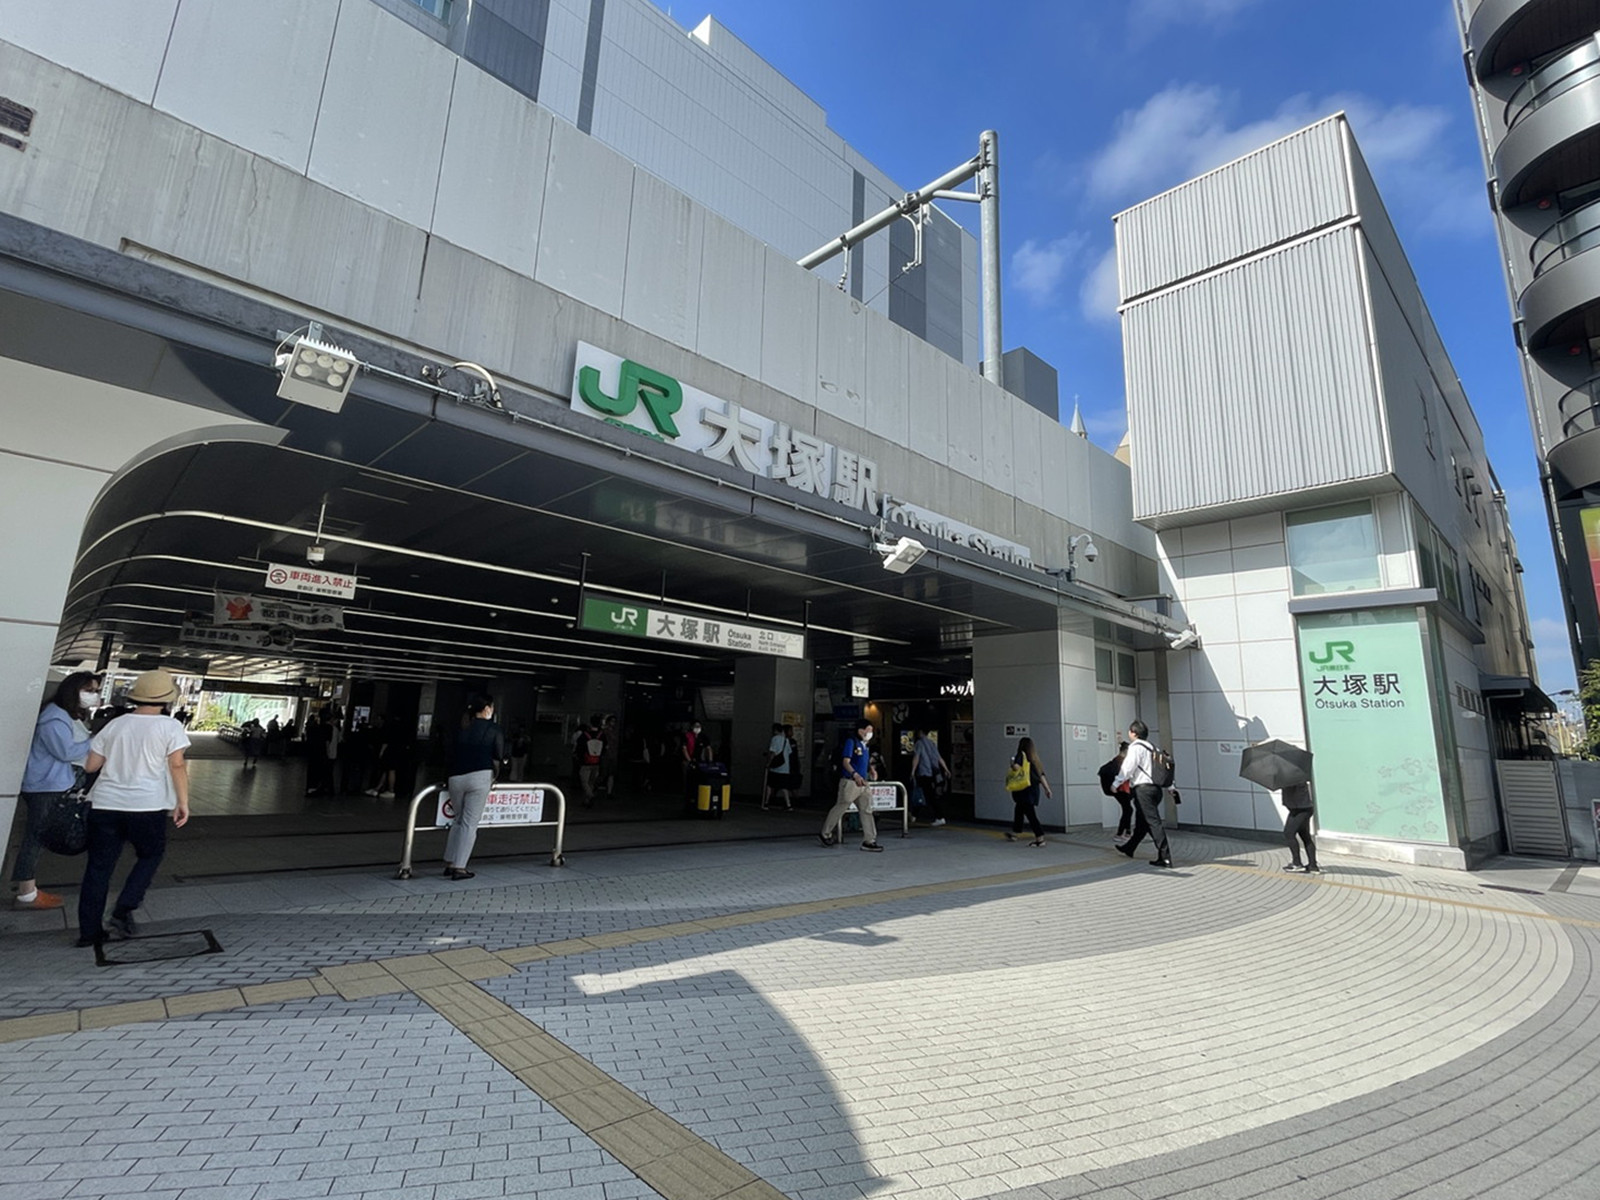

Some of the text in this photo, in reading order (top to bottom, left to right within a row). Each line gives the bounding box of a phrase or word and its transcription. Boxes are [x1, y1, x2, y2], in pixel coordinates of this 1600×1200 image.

[579, 359, 683, 438] JR
[700, 404, 880, 515] 大塚駅
[289, 571, 353, 589] 車両進入禁止
[611, 607, 638, 626] JR
[656, 615, 720, 644] 大塚駅
[758, 631, 774, 641] 北口
[727, 638, 752, 649] Station
[1309, 640, 1356, 664] JR
[1313, 673, 1401, 696] 大塚駅
[1315, 698, 1405, 709] Ōtsuka Station
